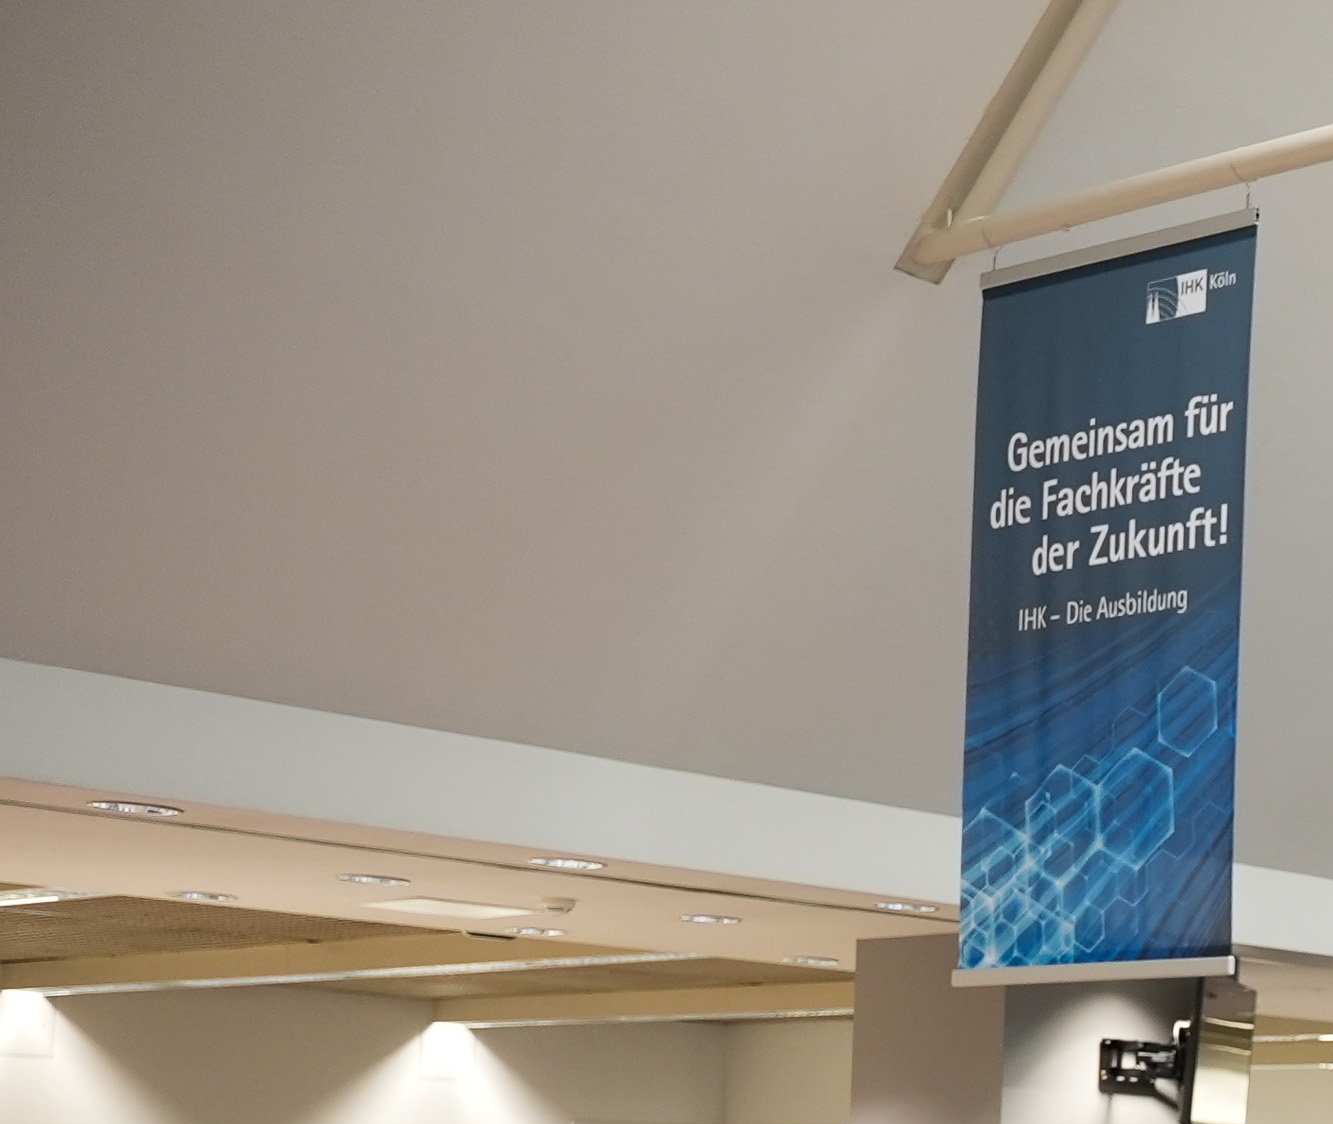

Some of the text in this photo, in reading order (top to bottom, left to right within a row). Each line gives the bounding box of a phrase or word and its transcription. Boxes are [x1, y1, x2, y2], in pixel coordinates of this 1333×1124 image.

[1180, 270, 1237, 296] IHK Köln
[1007, 394, 1234, 472] Gemeinsam für
[990, 457, 1202, 529] die Fachkräfte
[1031, 503, 1229, 576] der Zukunft!
[1018, 605, 1047, 632] IHK
[1066, 599, 1092, 625] Die
[1095, 587, 1188, 621] Ausbildung
